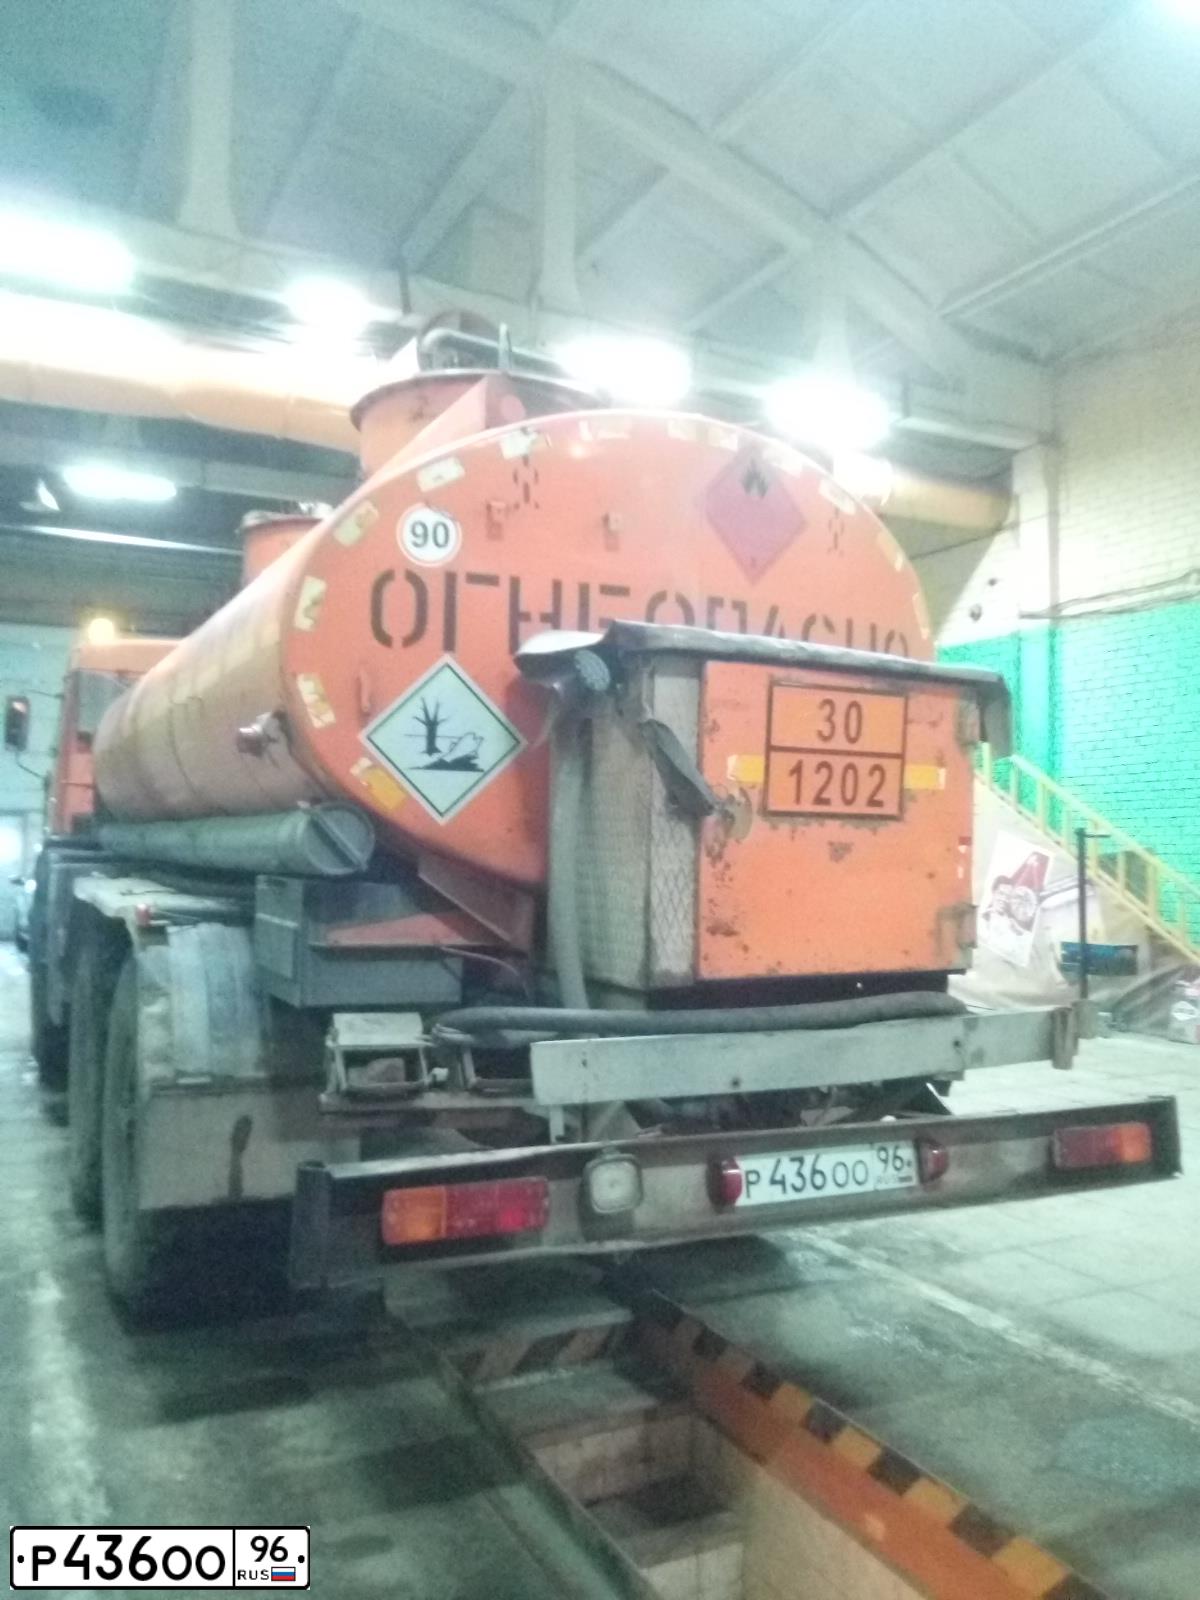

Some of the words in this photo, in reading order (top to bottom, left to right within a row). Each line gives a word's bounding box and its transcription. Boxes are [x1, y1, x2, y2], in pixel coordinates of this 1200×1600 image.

[410, 520, 449, 548] 90
[817, 698, 862, 744] 30
[788, 759, 886, 808] 1202
[876, 1146, 904, 1173] 96
